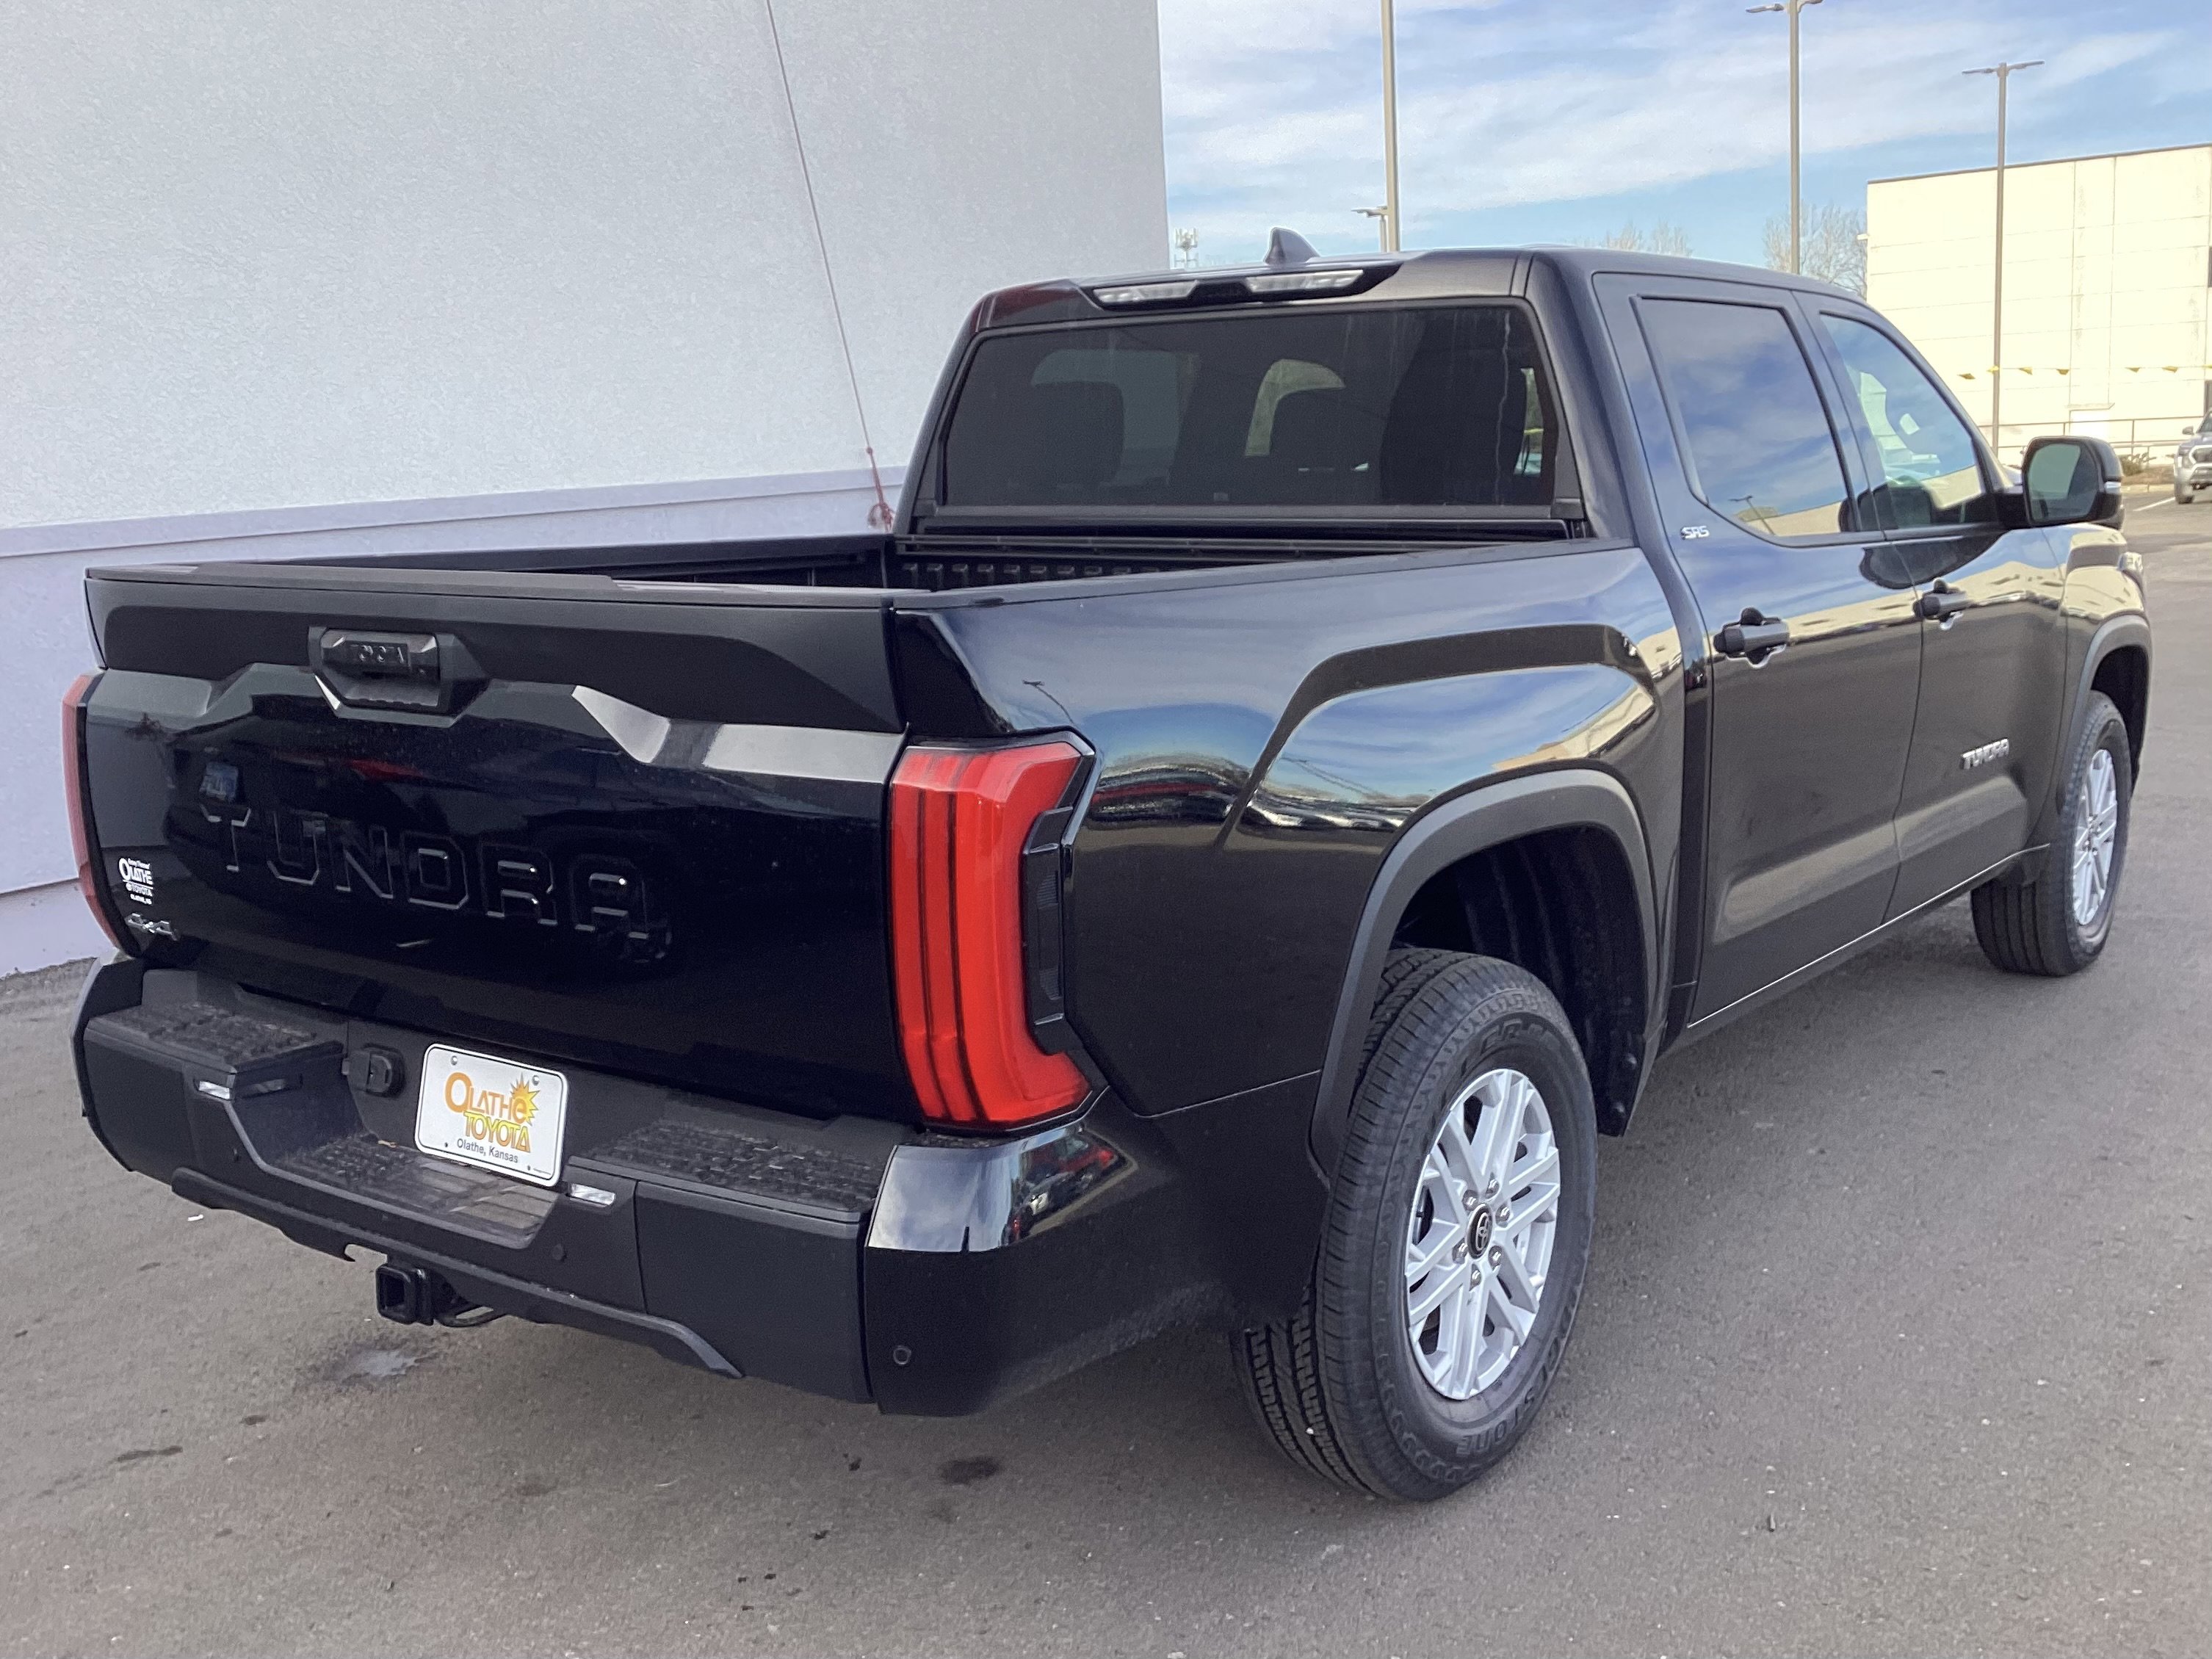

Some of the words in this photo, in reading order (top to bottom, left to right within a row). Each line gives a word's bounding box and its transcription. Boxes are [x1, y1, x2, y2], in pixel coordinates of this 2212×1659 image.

[198, 799, 651, 940] TUNDRA
[456, 1138, 487, 1157] Olathe,
[488, 1145, 518, 1163] Kansas
[463, 1112, 531, 1153] TOYOTA
